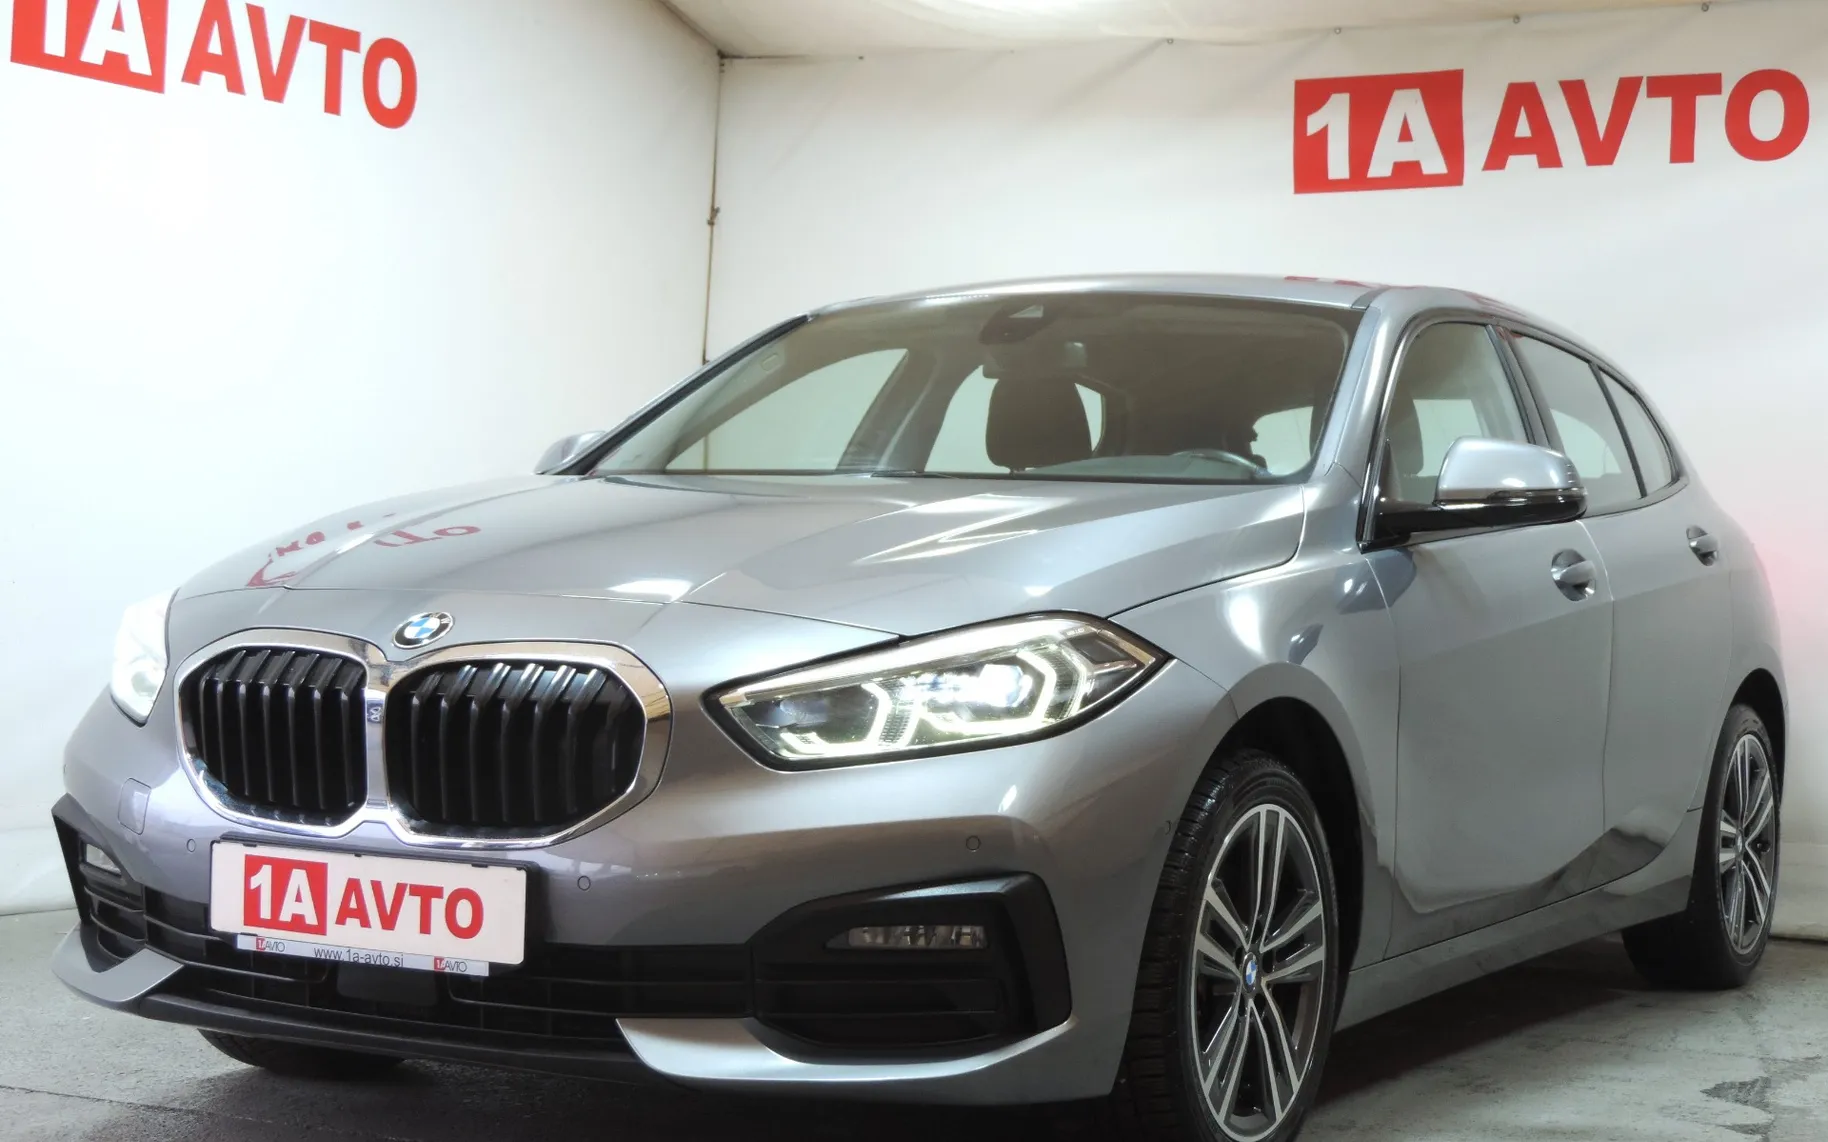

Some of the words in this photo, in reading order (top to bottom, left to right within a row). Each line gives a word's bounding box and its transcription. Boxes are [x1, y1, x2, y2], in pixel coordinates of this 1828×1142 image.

[181, 0, 418, 129] AVTO
[1307, 88, 1448, 180] 1A
[1481, 69, 1810, 171] AVTO
[250, 864, 318, 926] 1A
[335, 877, 484, 939] AVTO
[313, 947, 404, 967] www.1a-avto.si
